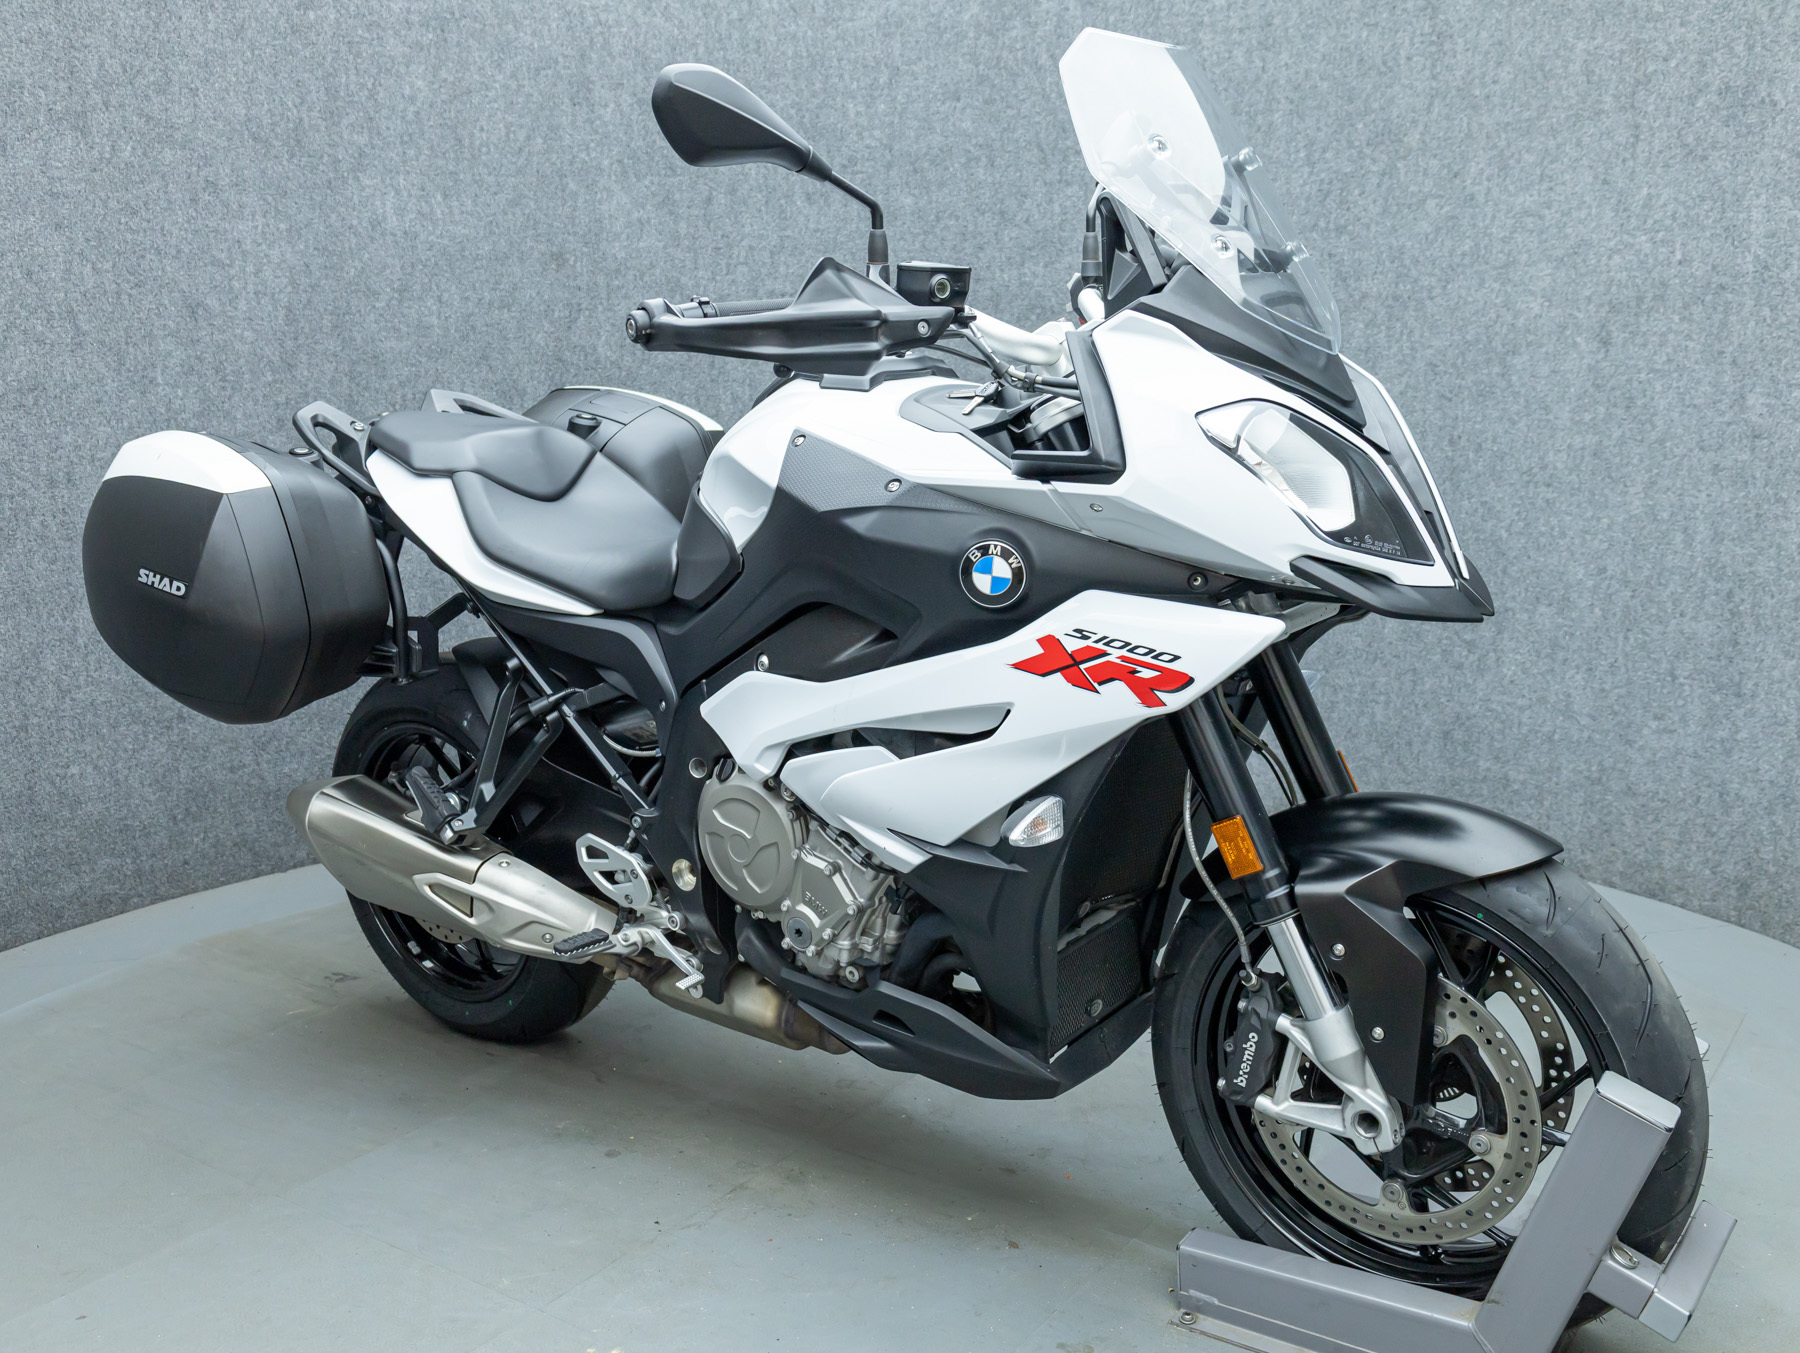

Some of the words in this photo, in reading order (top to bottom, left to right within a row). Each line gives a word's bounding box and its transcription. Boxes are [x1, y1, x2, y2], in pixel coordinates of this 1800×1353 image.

[968, 544, 1021, 569] BMW
[137, 568, 186, 596] SHAD
[1063, 628, 1182, 663] S1000
[1006, 634, 1195, 708] XR
[1233, 1032, 1258, 1088] brembo
